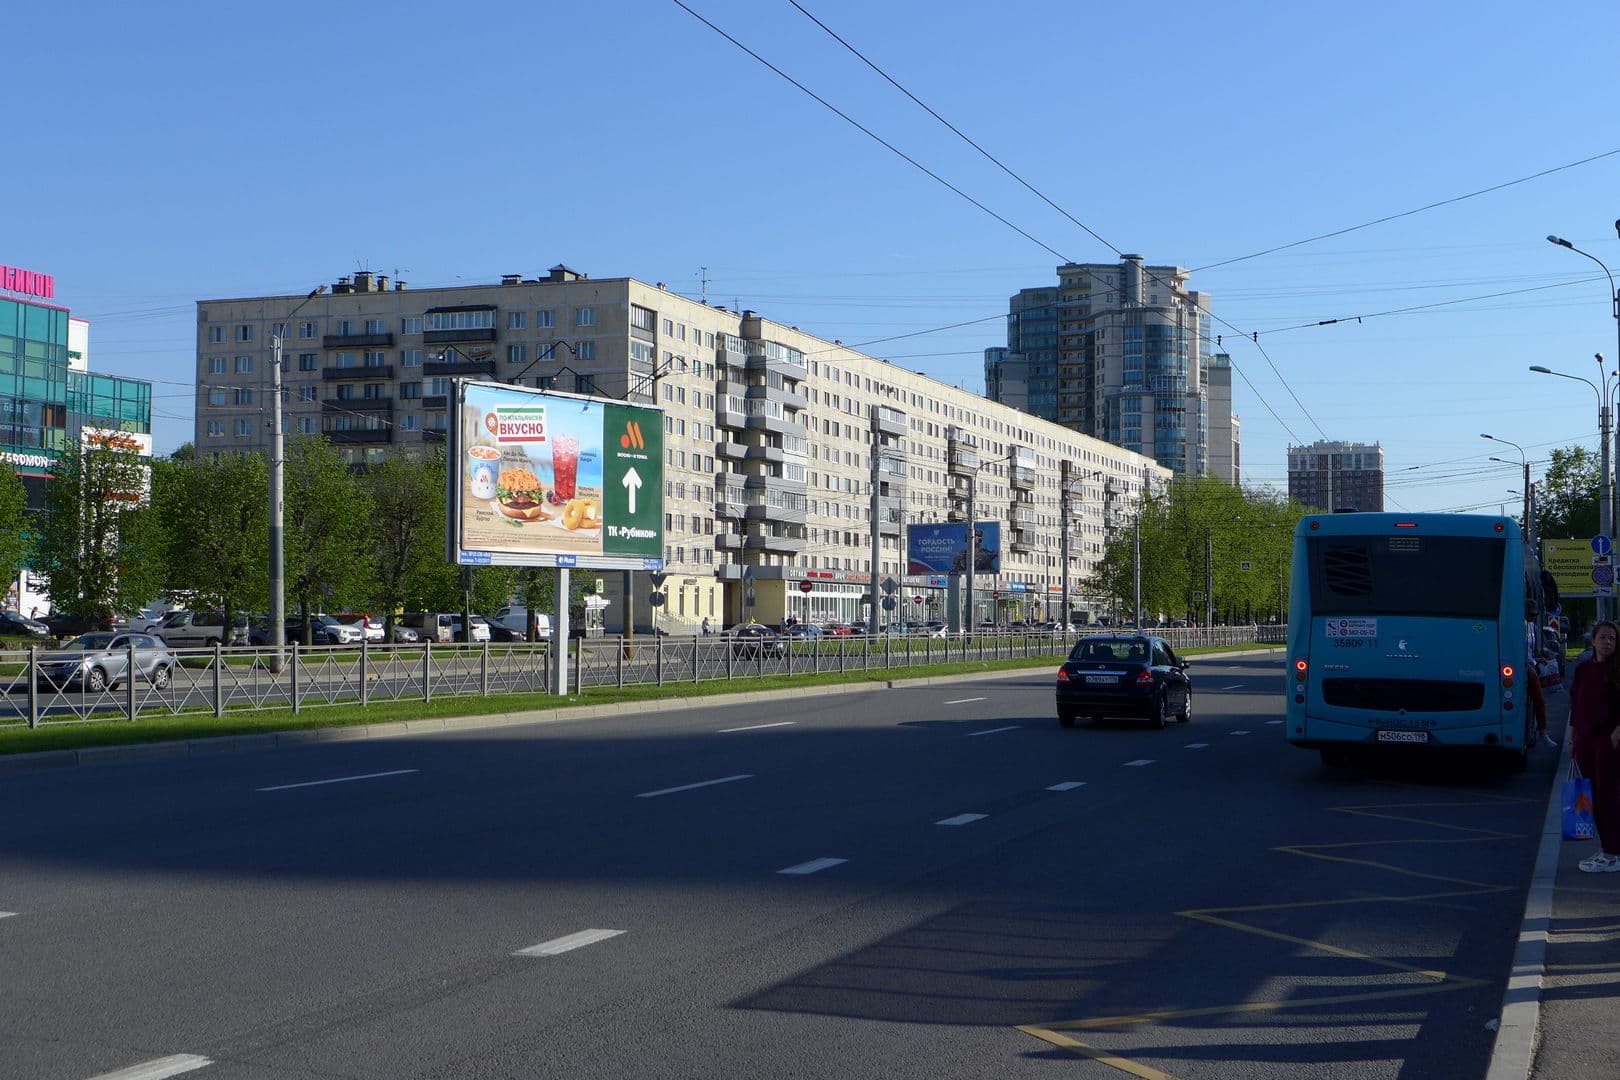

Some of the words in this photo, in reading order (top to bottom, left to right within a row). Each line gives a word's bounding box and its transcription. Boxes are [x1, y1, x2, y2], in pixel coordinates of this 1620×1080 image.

[499, 422, 544, 435] ВКУСНО
[608, 525, 618, 537] ТК
[918, 537, 956, 546] ГОРДОСТЬ
[1335, 639, 1363, 649] 35809
[1368, 639, 1378, 649] 11
